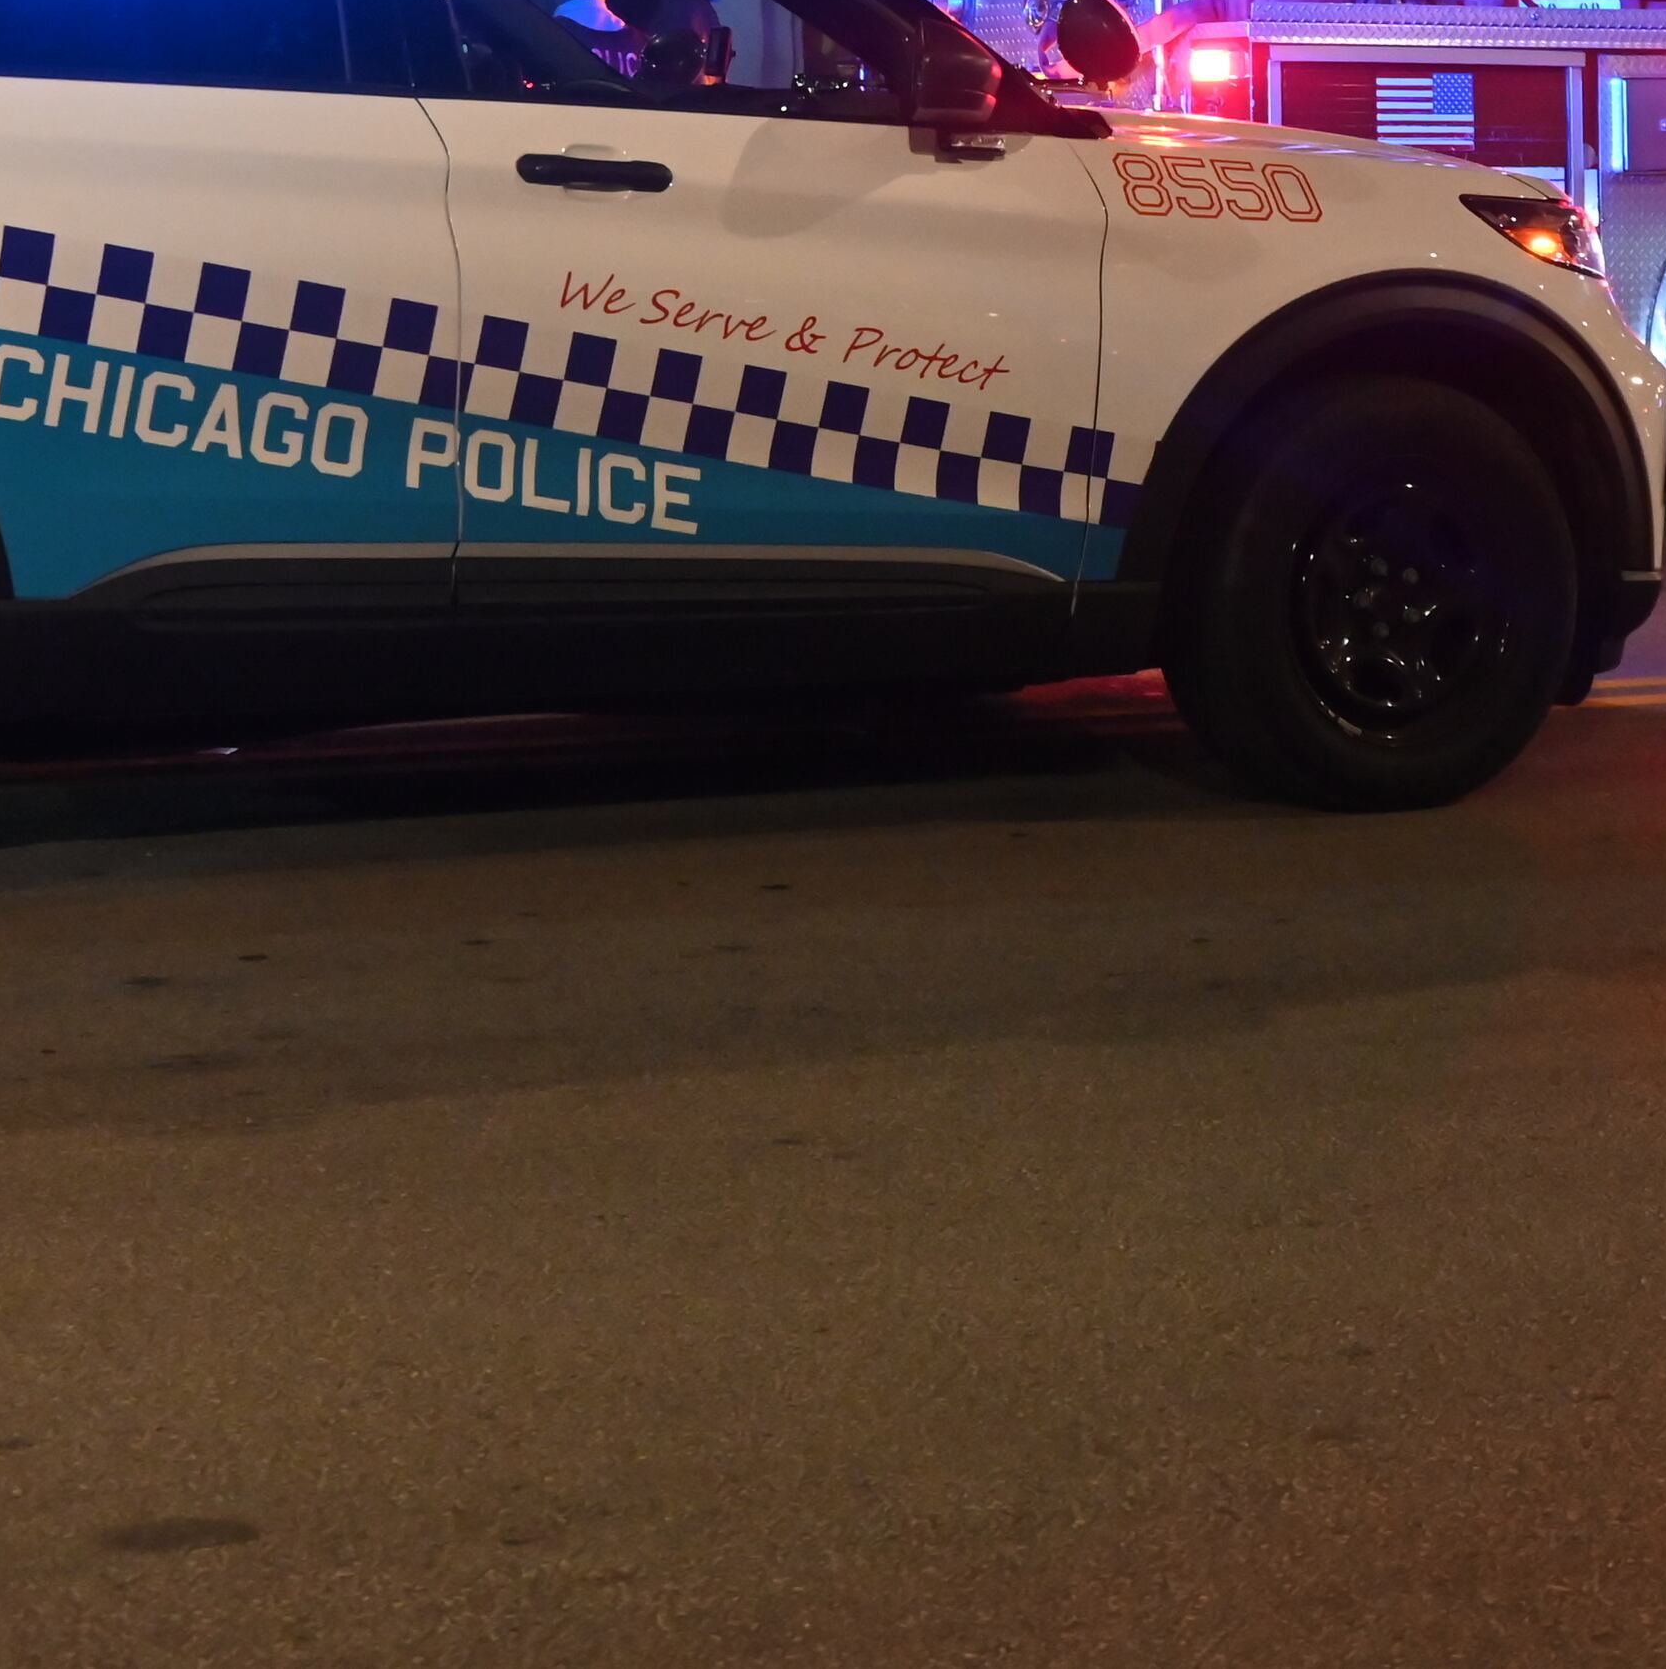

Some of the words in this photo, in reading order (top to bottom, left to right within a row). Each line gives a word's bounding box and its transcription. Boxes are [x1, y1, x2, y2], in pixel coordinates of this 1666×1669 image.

[1112, 153, 1323, 223] 8550
[559, 271, 636, 315] We
[639, 289, 776, 341] Serve
[784, 315, 826, 355] &
[842, 327, 1011, 391] Protect
[404, 417, 702, 536] POLICE
